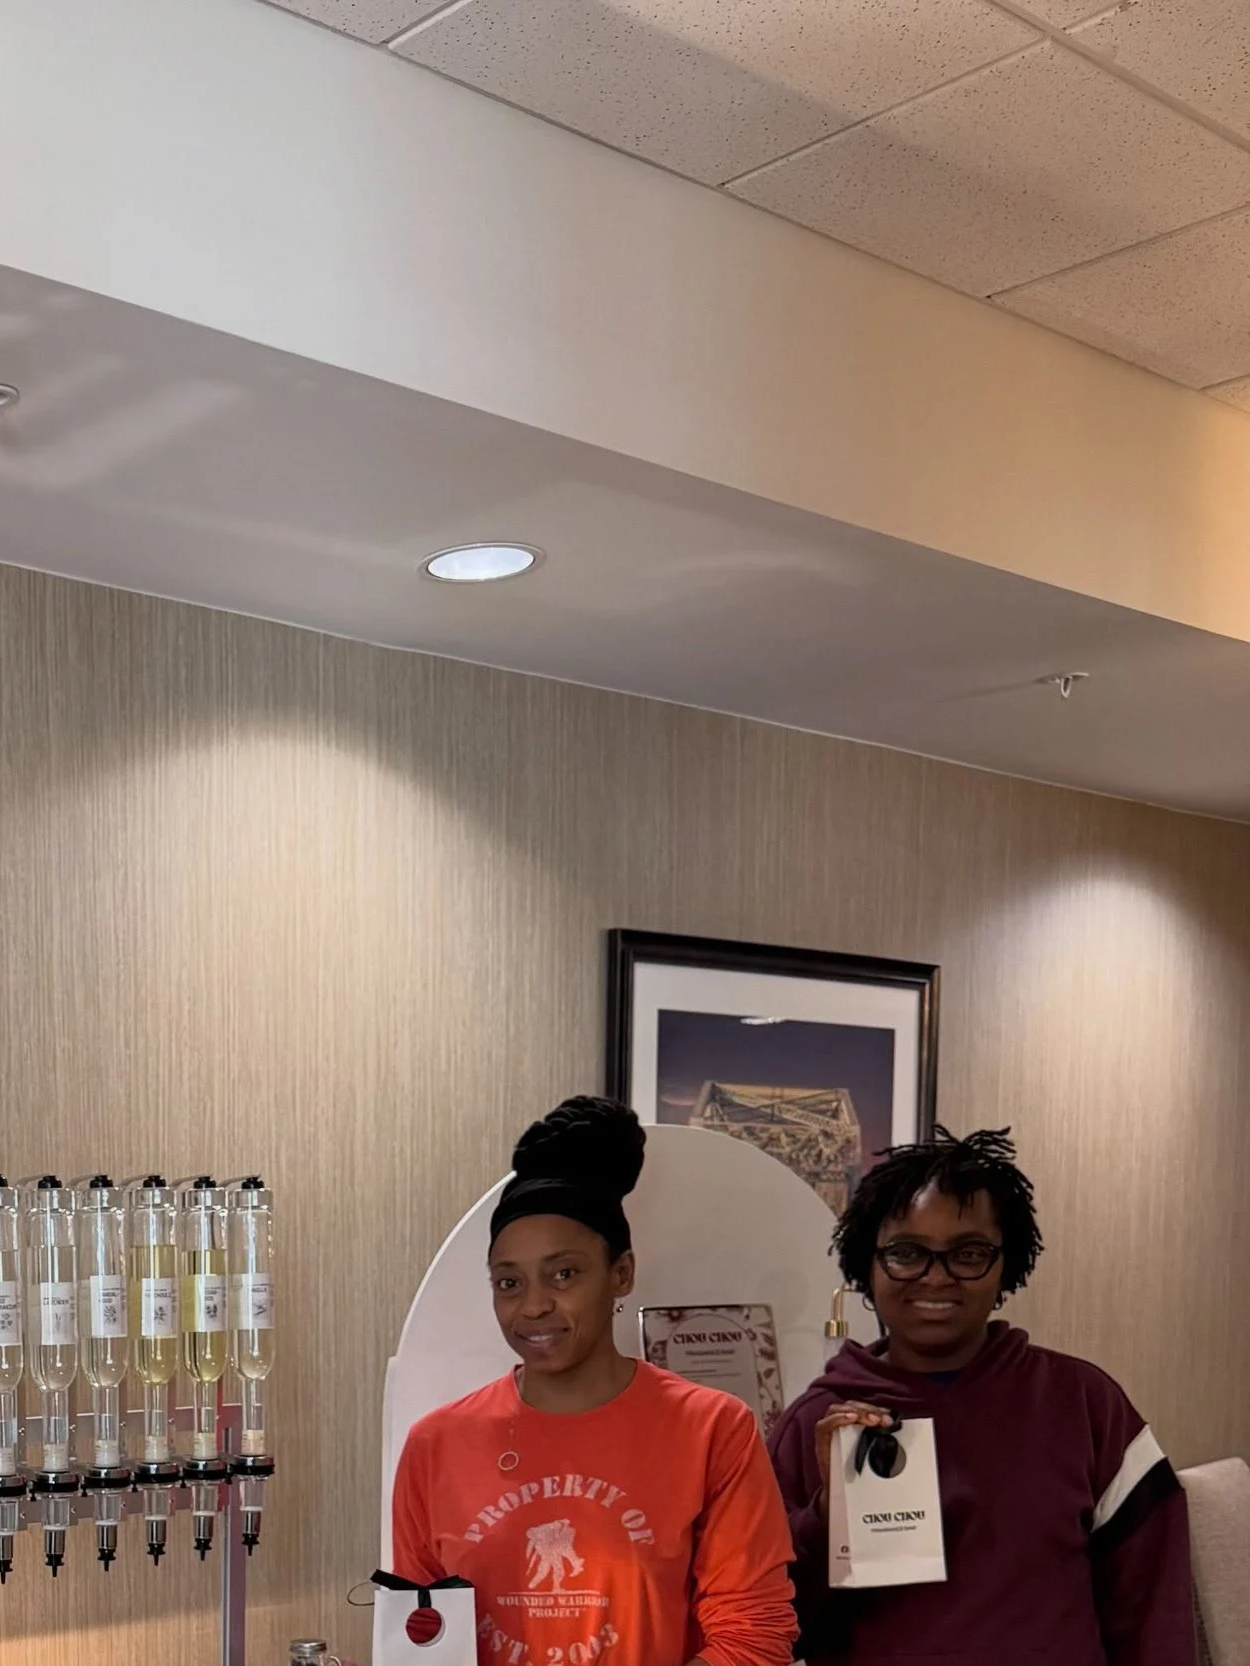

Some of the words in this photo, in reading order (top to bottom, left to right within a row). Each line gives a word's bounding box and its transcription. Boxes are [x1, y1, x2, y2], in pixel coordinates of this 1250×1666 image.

[673, 1333, 706, 1344] CHOU
[709, 1332, 742, 1343] CHOU
[463, 1474, 627, 1544] PROPERTY
[621, 1509, 655, 1545] OF
[862, 1512, 892, 1524] CHOU
[894, 1510, 925, 1522] CHOU
[497, 1596, 554, 1606] WOUNDED
[528, 1607, 581, 1618] PROJECT
